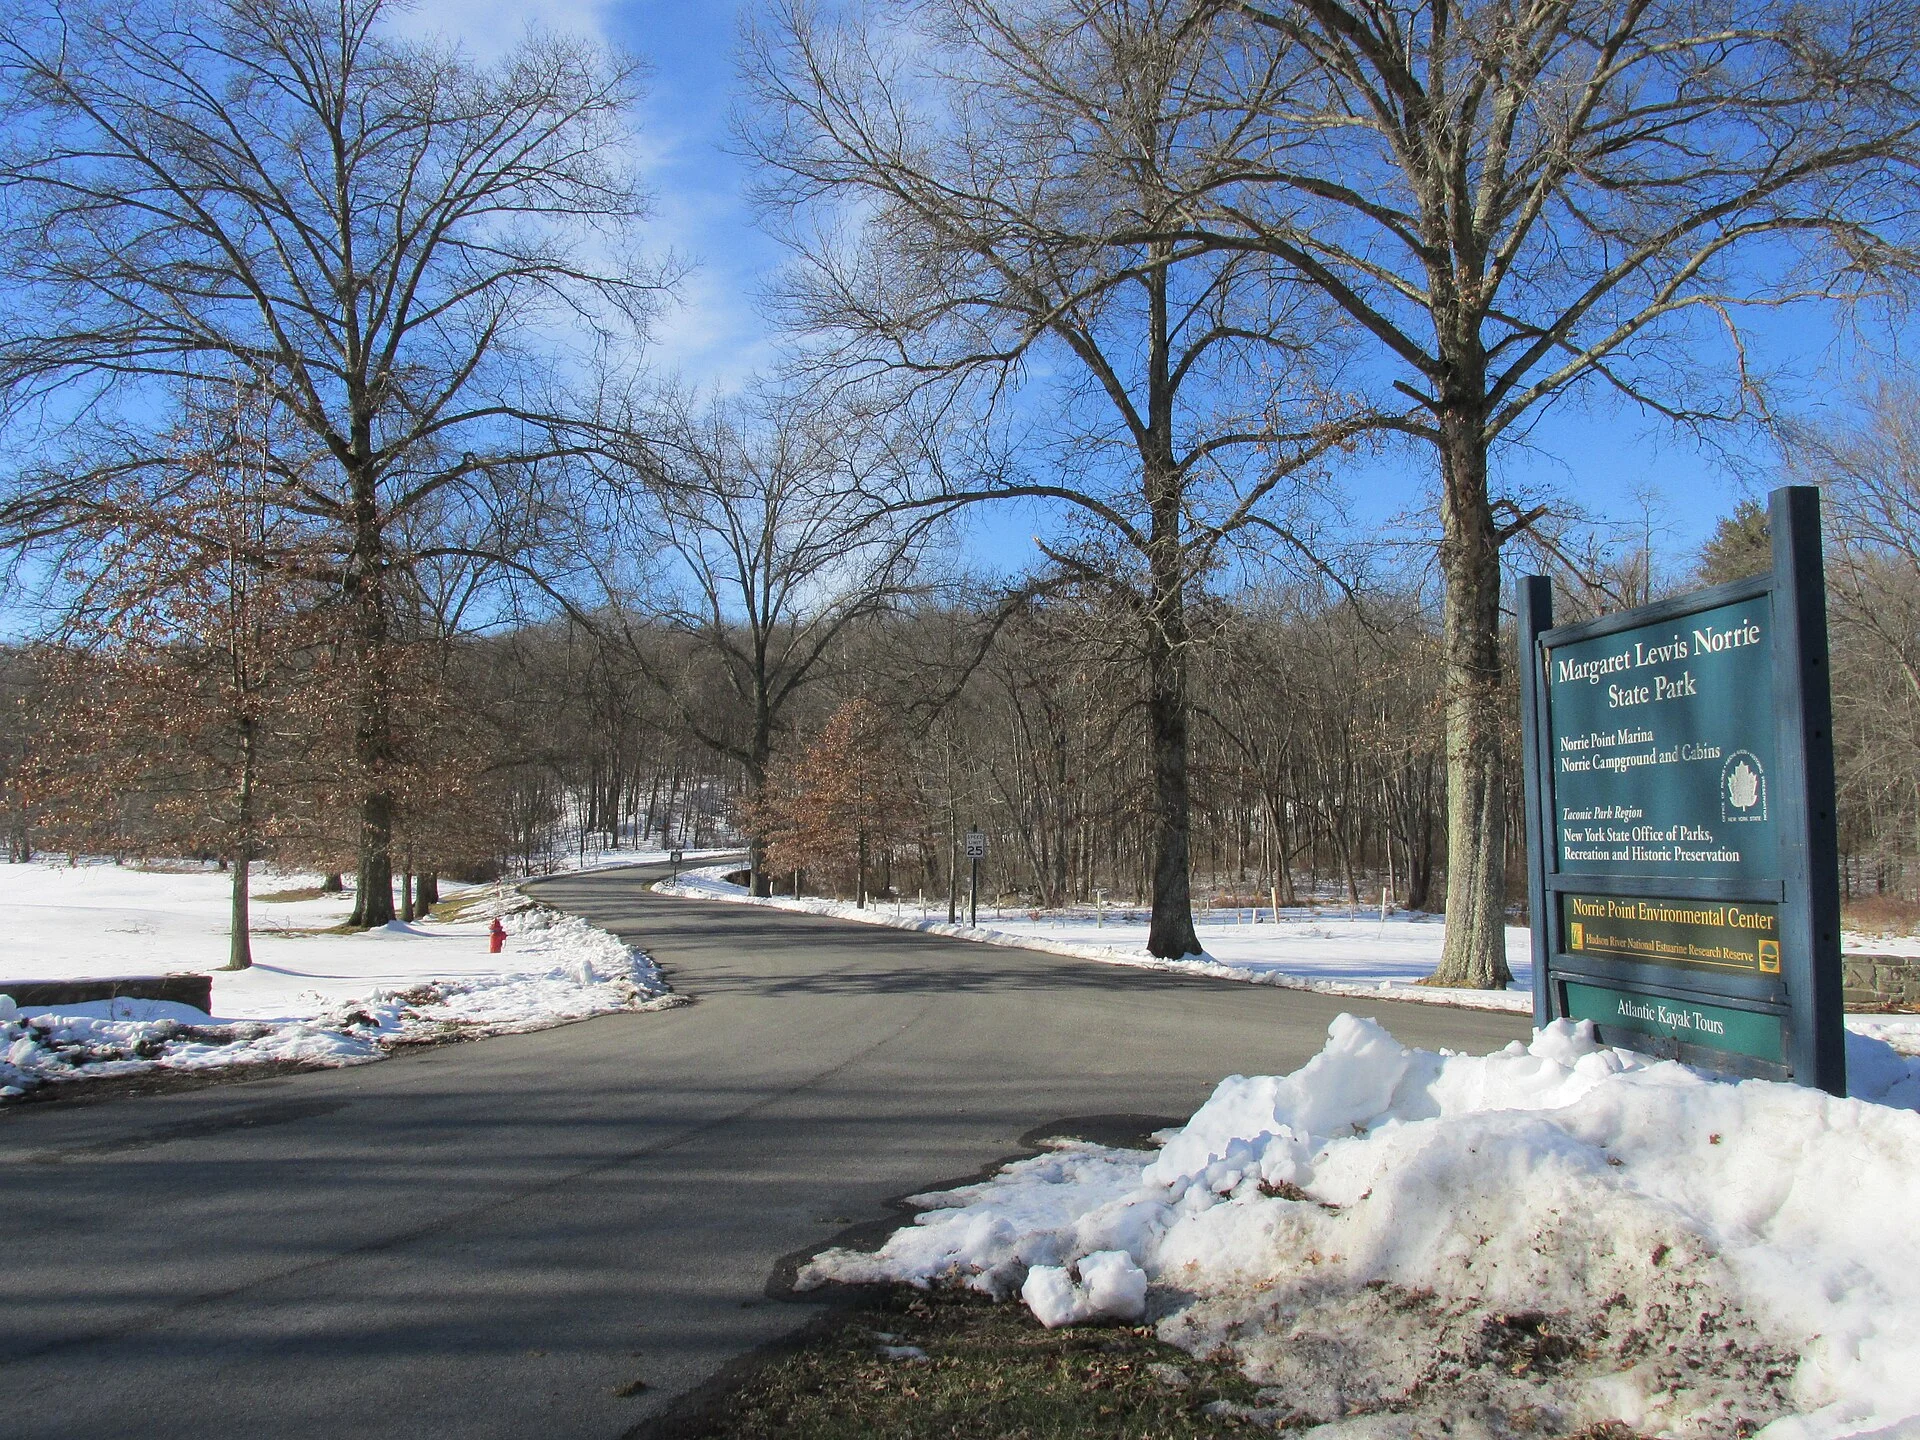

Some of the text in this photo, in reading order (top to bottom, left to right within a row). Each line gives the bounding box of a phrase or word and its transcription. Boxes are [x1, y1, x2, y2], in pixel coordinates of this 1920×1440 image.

[1558, 618, 1760, 685] Margaret Lewis Norrie
[1608, 671, 1697, 708] State Park
[1560, 727, 1654, 752] Norrie Point Marina
[1561, 742, 1721, 773] Norrie Campground and Cabins
[1562, 805, 1643, 823] Taconic Park Region
[1563, 824, 1713, 844] New York State Office of Parks,
[967, 846, 983, 856] 25
[1564, 846, 1740, 862] Recreation and Historic Preservation
[1573, 898, 1774, 930] Norrie Point Environmental Center
[1586, 933, 1754, 962] Hudson River National Estuarine Research Reserve
[1617, 999, 1724, 1035] Atlantic Kayak Tours
